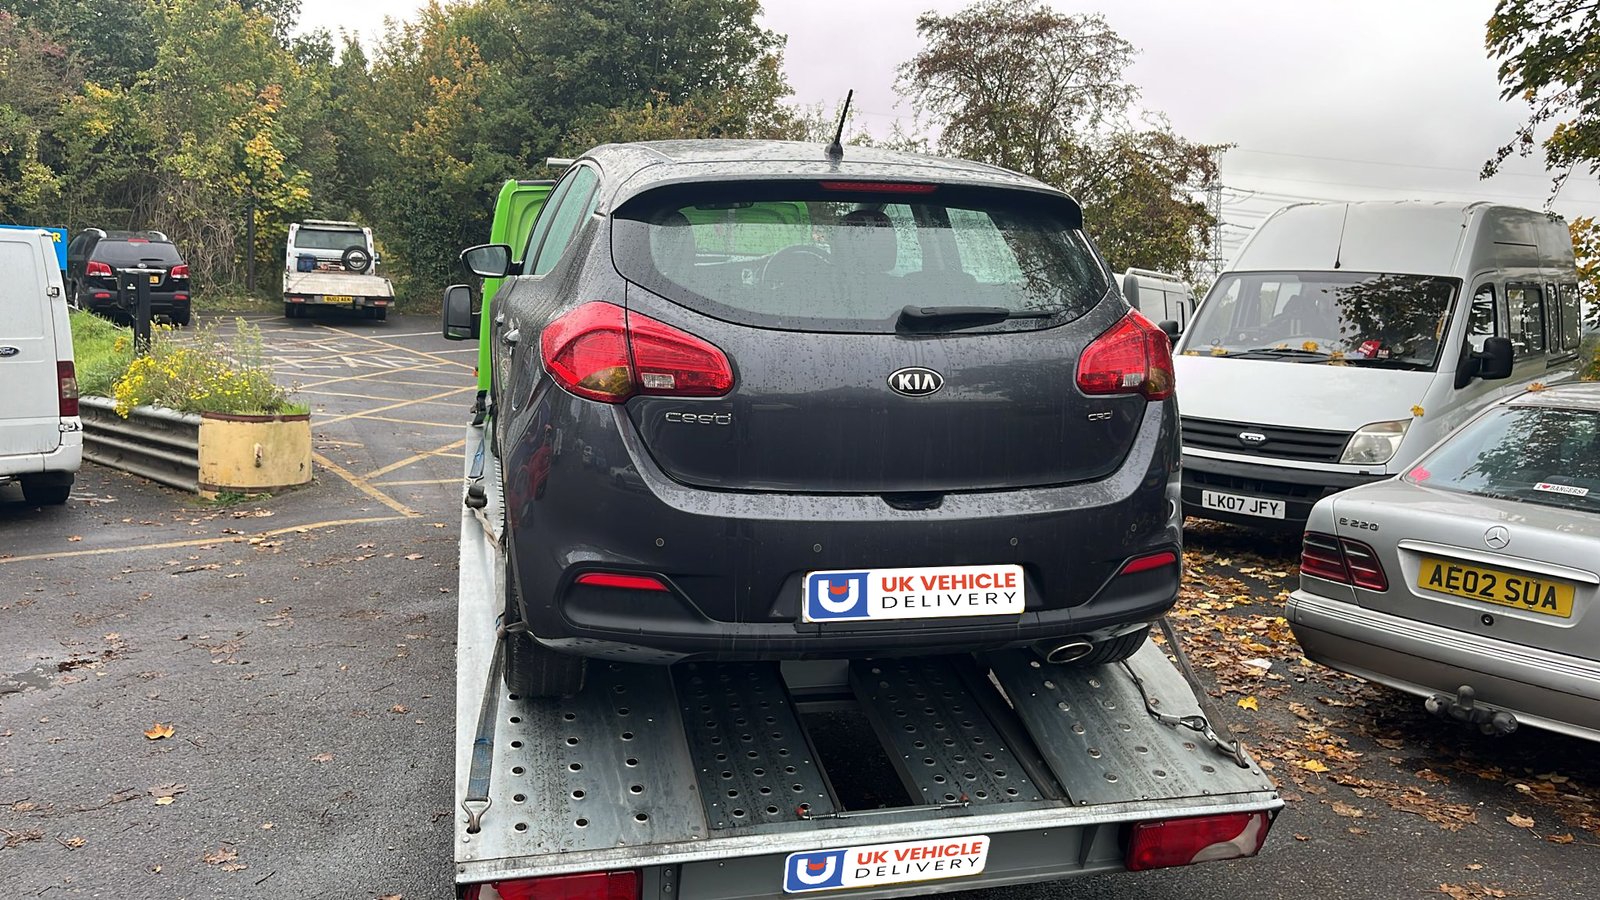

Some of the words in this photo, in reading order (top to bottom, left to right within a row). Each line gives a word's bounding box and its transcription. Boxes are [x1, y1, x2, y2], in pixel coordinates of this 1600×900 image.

[898, 373, 936, 390] KIA
[1208, 493, 1246, 511] LK07
[1249, 500, 1279, 515] JFY
[1339, 517, 1349, 526] E
[1350, 519, 1379, 532] 220
[1429, 564, 1497, 598] AE02
[1504, 578, 1557, 610] SUA
